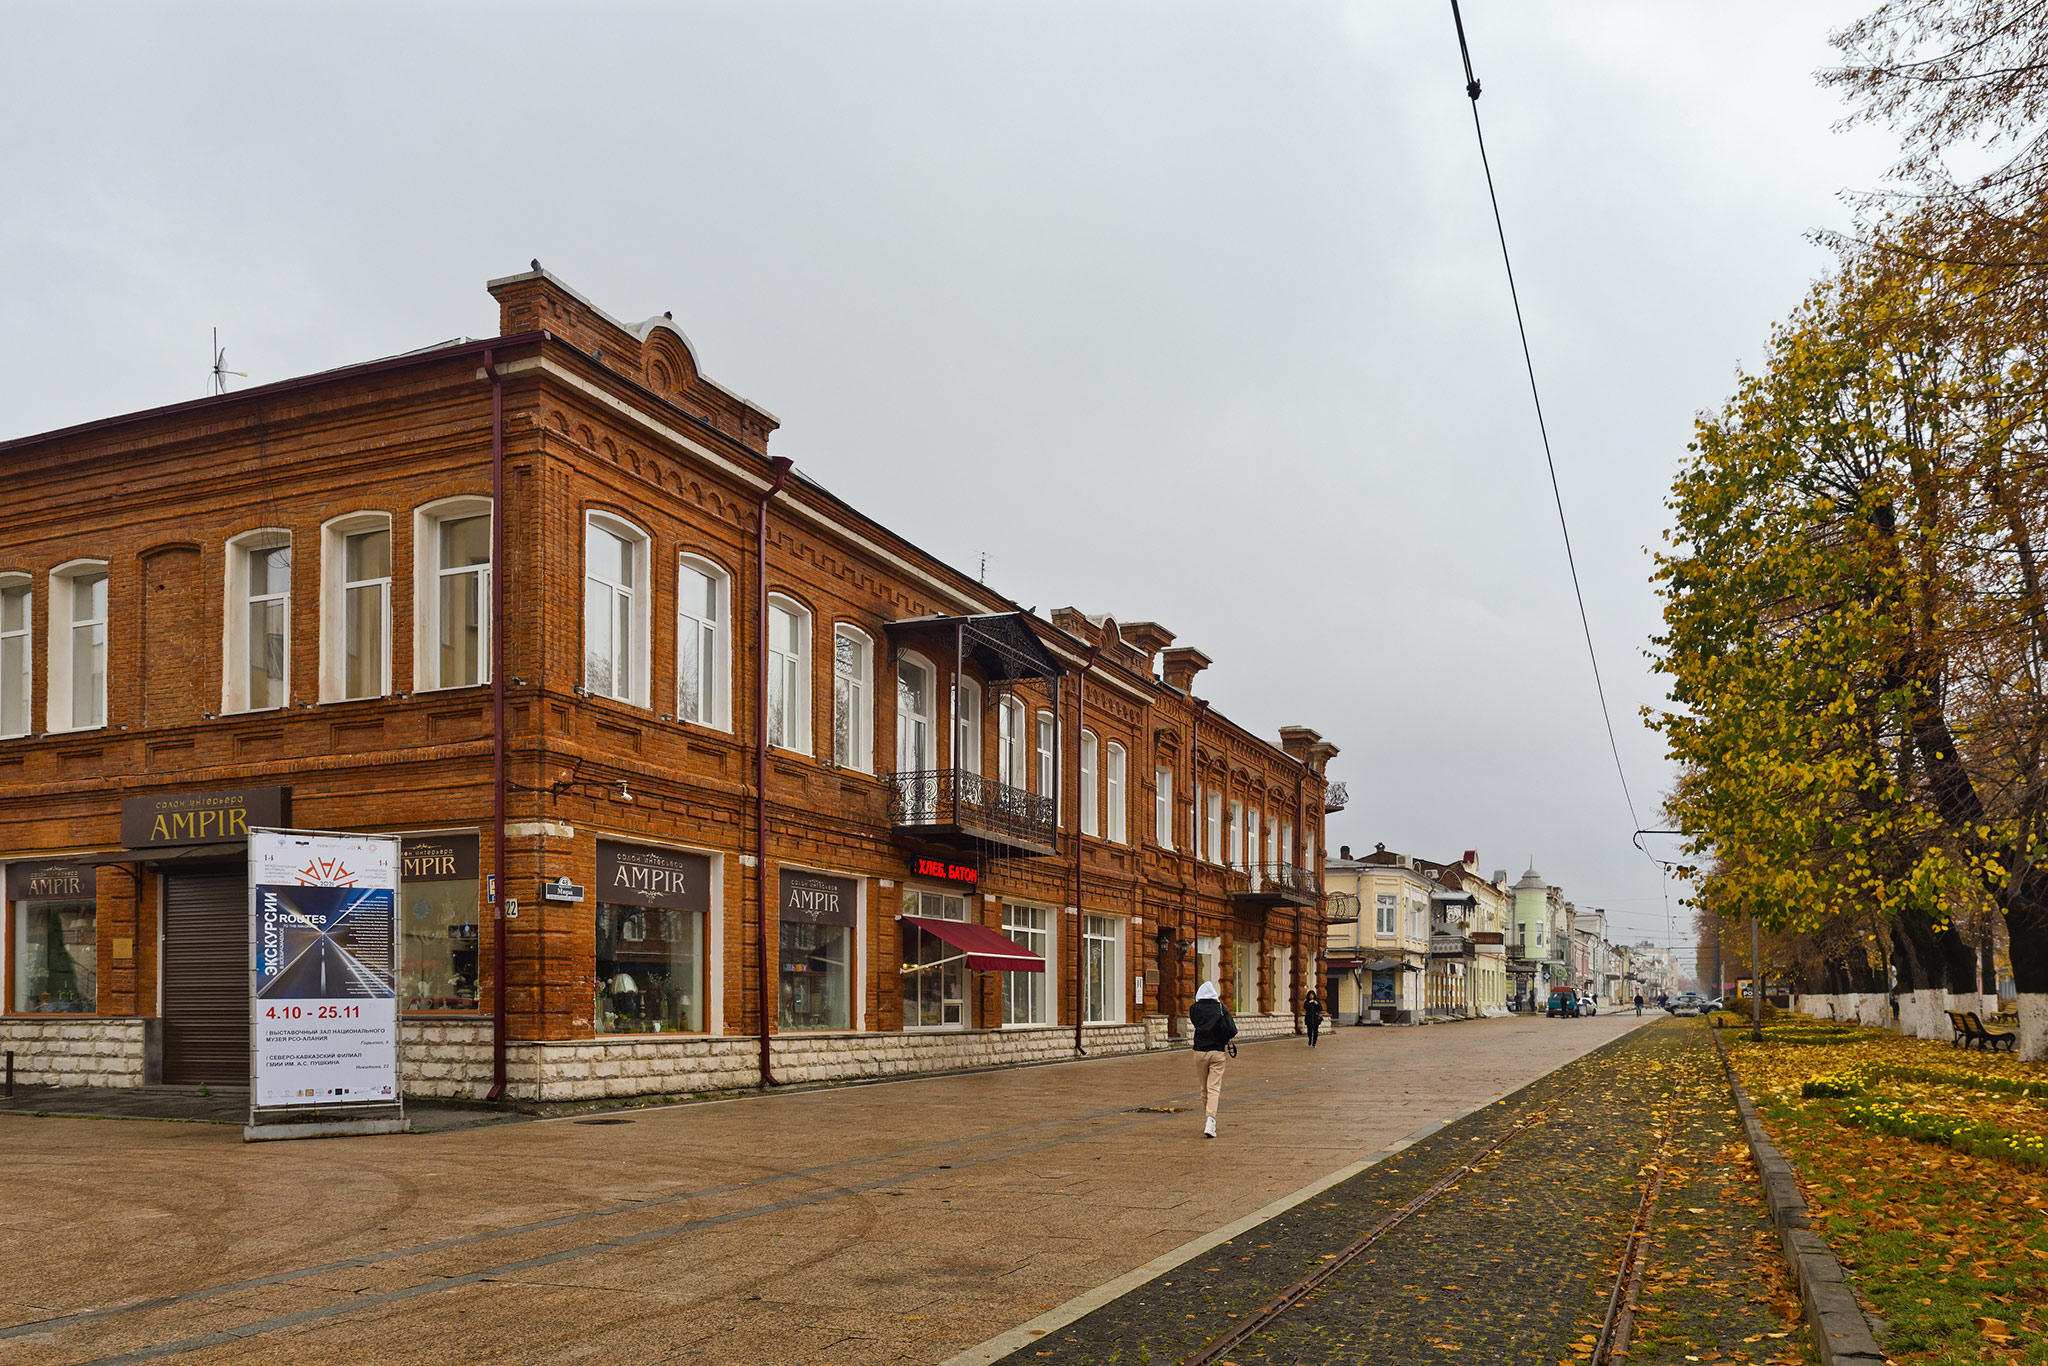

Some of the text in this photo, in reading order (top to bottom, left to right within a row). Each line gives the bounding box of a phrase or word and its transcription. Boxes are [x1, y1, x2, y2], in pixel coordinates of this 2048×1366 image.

[155, 800, 185, 809] салон
[150, 808, 249, 841] AMPIR
[401, 857, 456, 876] MPIR
[918, 859, 947, 879] ХЛЕБ,
[948, 864, 978, 883] БАТОН
[28, 878, 81, 895] AMPIR
[613, 865, 686, 894] AMPIR
[506, 901, 517, 915] 22
[788, 889, 840, 913] AMPIR
[280, 914, 327, 924] ROUTES
[264, 892, 278, 976] ЭКСКУРСИИ
[266, 1006, 302, 1020] 4.10
[318, 1005, 360, 1019] 25.11
[269, 1053, 336, 1061] СЕВЕРО-КАВКАЗСКИЙ
